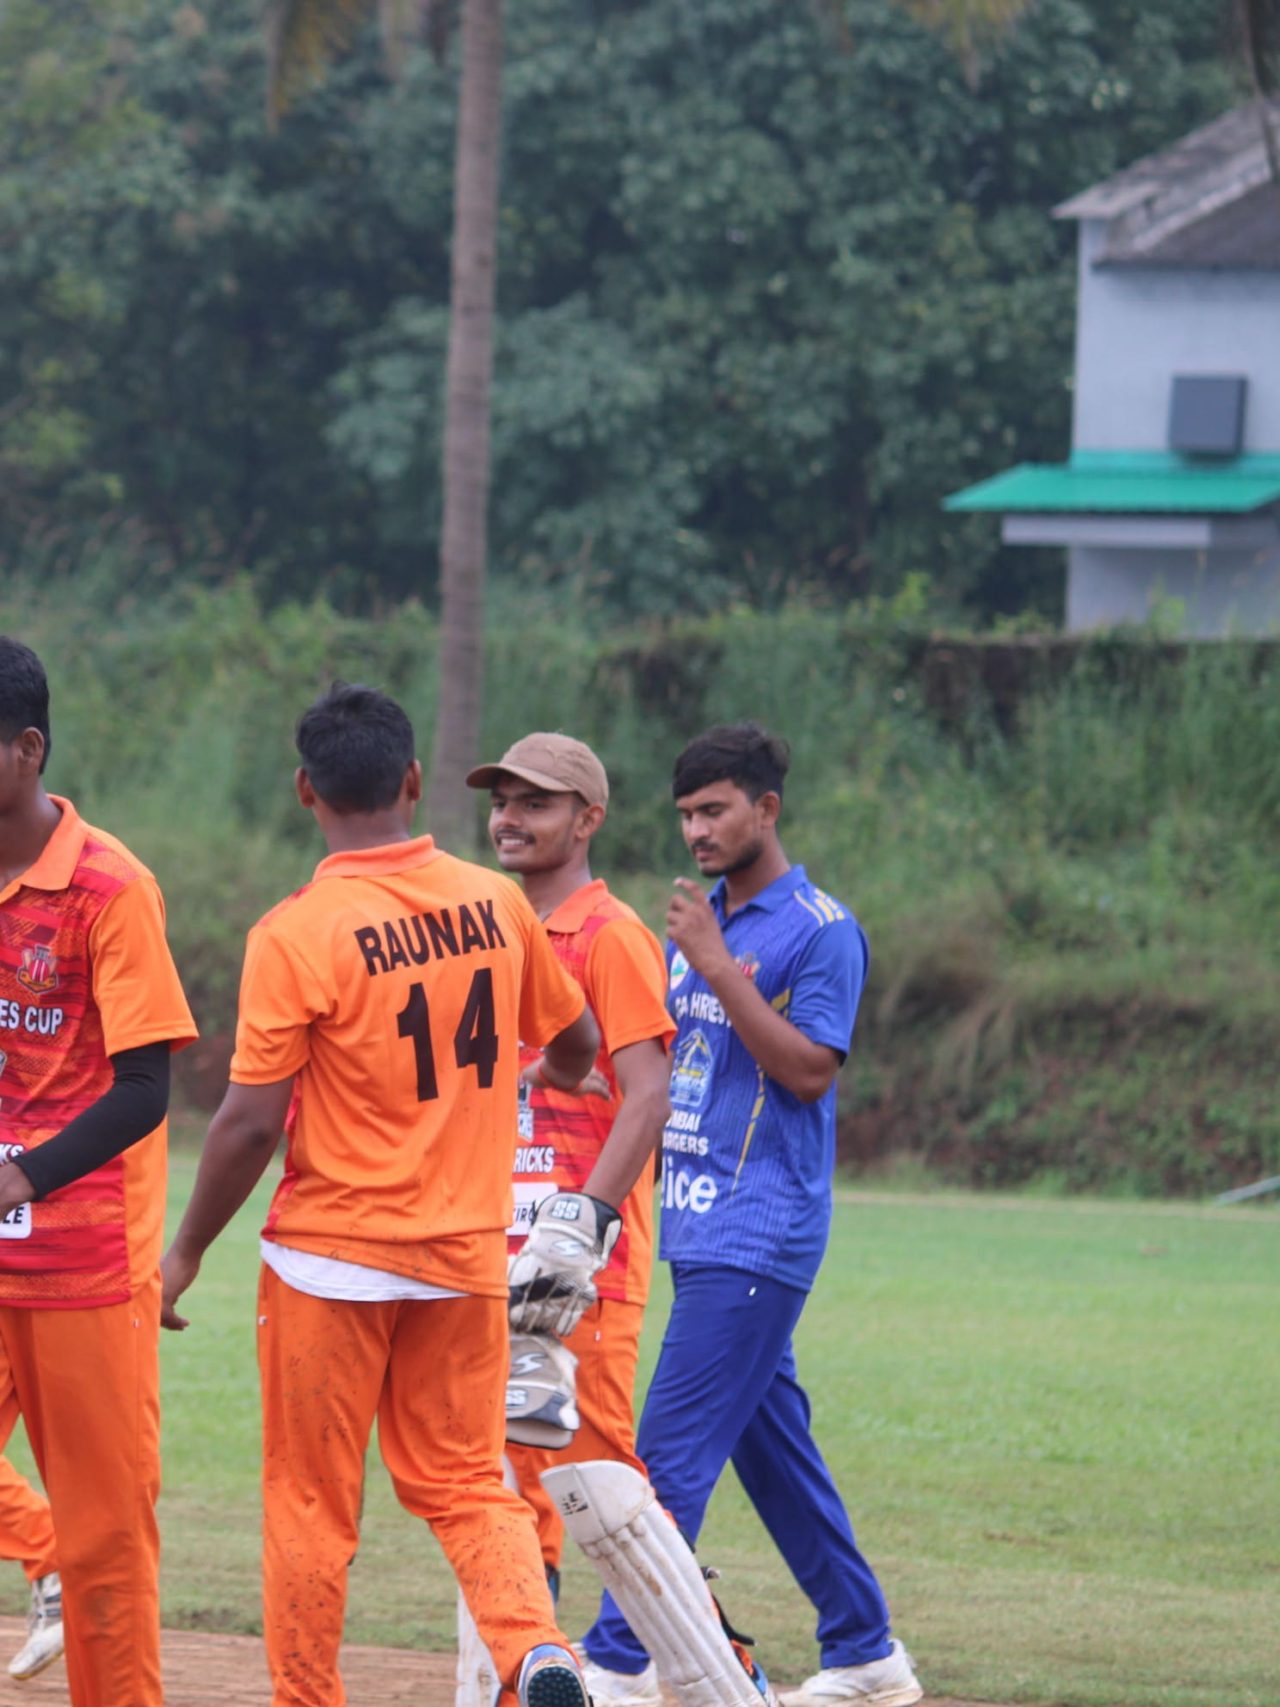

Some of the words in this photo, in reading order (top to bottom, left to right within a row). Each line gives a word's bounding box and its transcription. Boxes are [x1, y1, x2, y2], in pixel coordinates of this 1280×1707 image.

[354, 899, 507, 977] RAUNAK
[24, 1006, 63, 1036] CUP
[396, 967, 498, 1103] 14
[513, 1147, 554, 1173] RICKS
